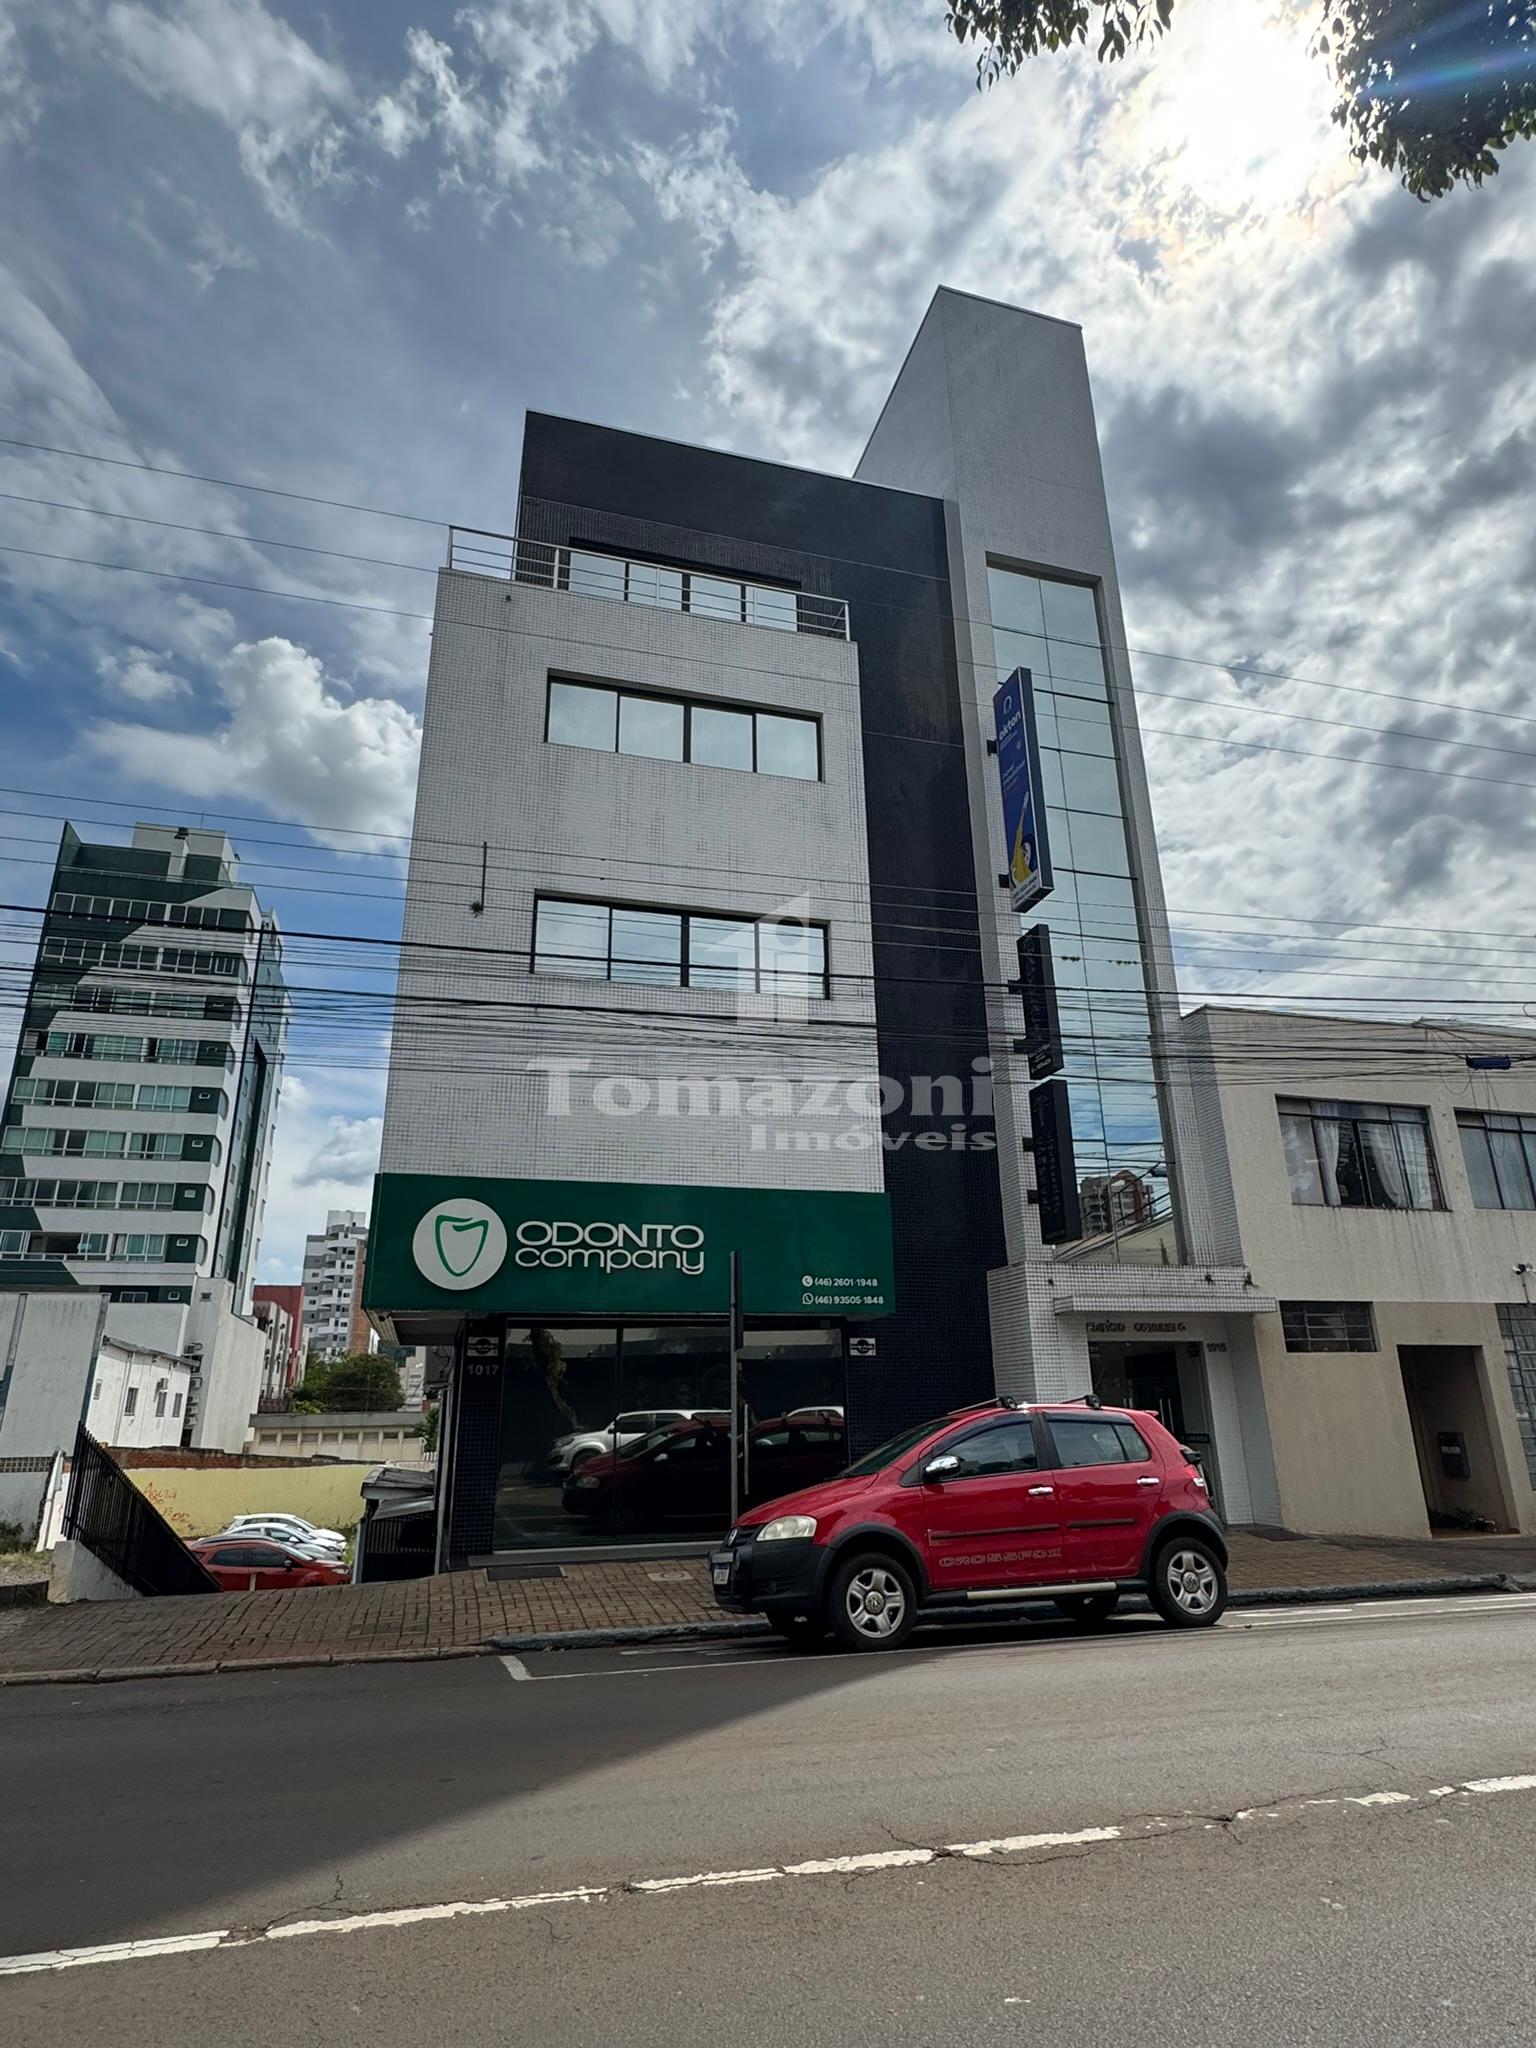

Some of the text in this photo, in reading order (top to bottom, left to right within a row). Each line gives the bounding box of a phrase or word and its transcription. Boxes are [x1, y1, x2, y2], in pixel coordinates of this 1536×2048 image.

[516, 1220, 705, 1249] ODONTO
[515, 1247, 705, 1276] company
[814, 1277, 832, 1287] (46)
[814, 1295, 832, 1305] (46)
[467, 1364, 500, 1376] 1017
